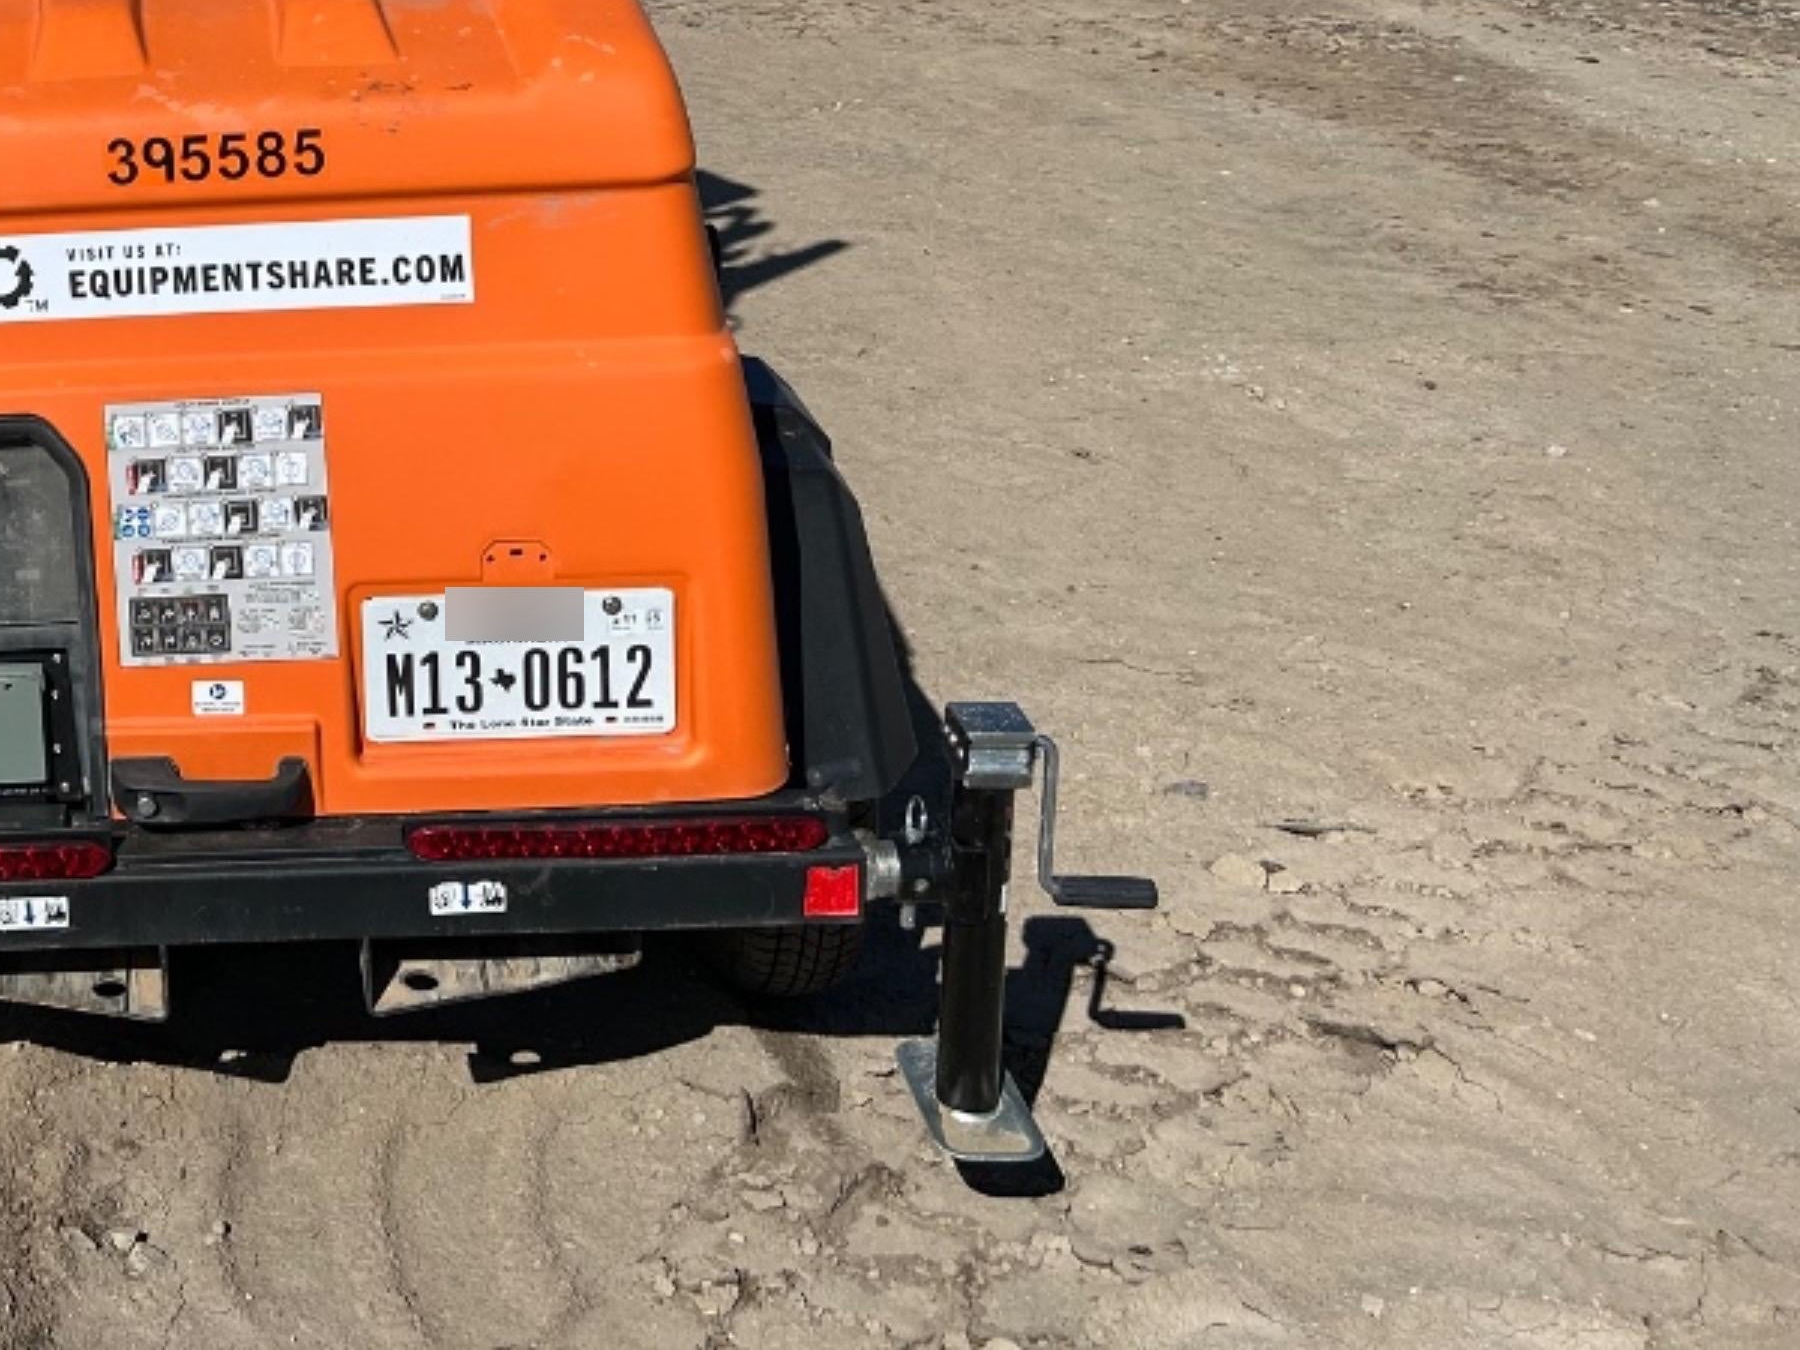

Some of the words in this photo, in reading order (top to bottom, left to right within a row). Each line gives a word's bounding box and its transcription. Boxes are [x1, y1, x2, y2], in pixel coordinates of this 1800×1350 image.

[106, 127, 327, 186] 395585
[66, 245, 115, 262] VISIT
[122, 244, 146, 260] US
[154, 241, 182, 257] AT:
[67, 253, 466, 300] EQUIPMENTSHARE.COM
